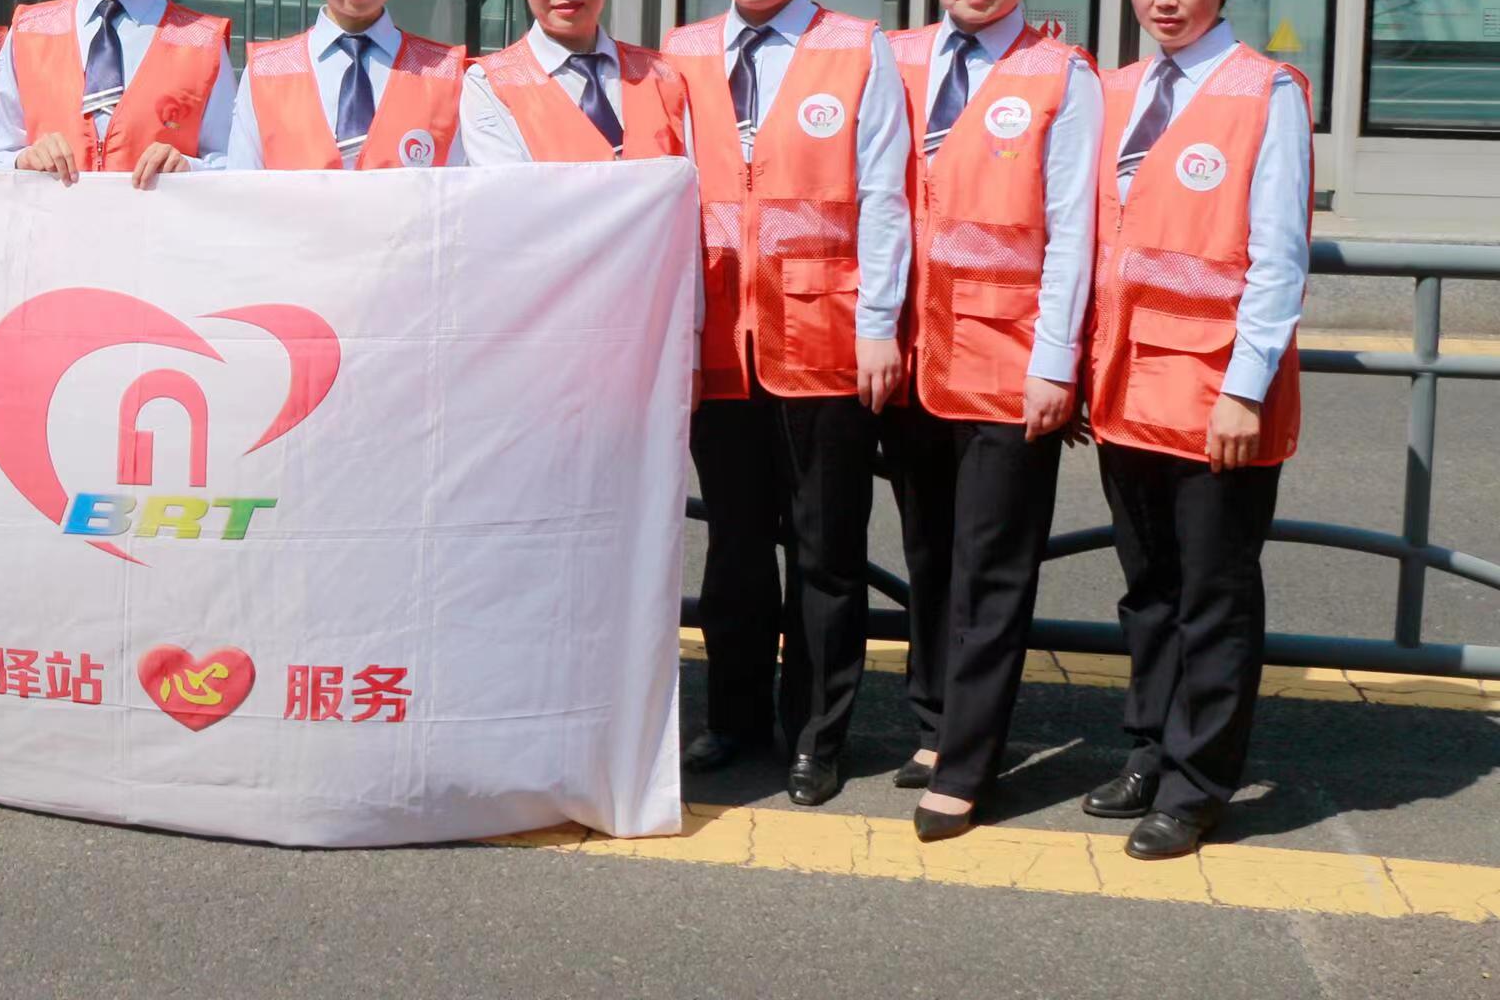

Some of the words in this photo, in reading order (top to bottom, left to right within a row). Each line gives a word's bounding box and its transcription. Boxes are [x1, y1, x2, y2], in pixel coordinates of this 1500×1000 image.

[62, 492, 278, 541] BRT
[160, 662, 230, 706] 心
[283, 663, 414, 724] 服务
